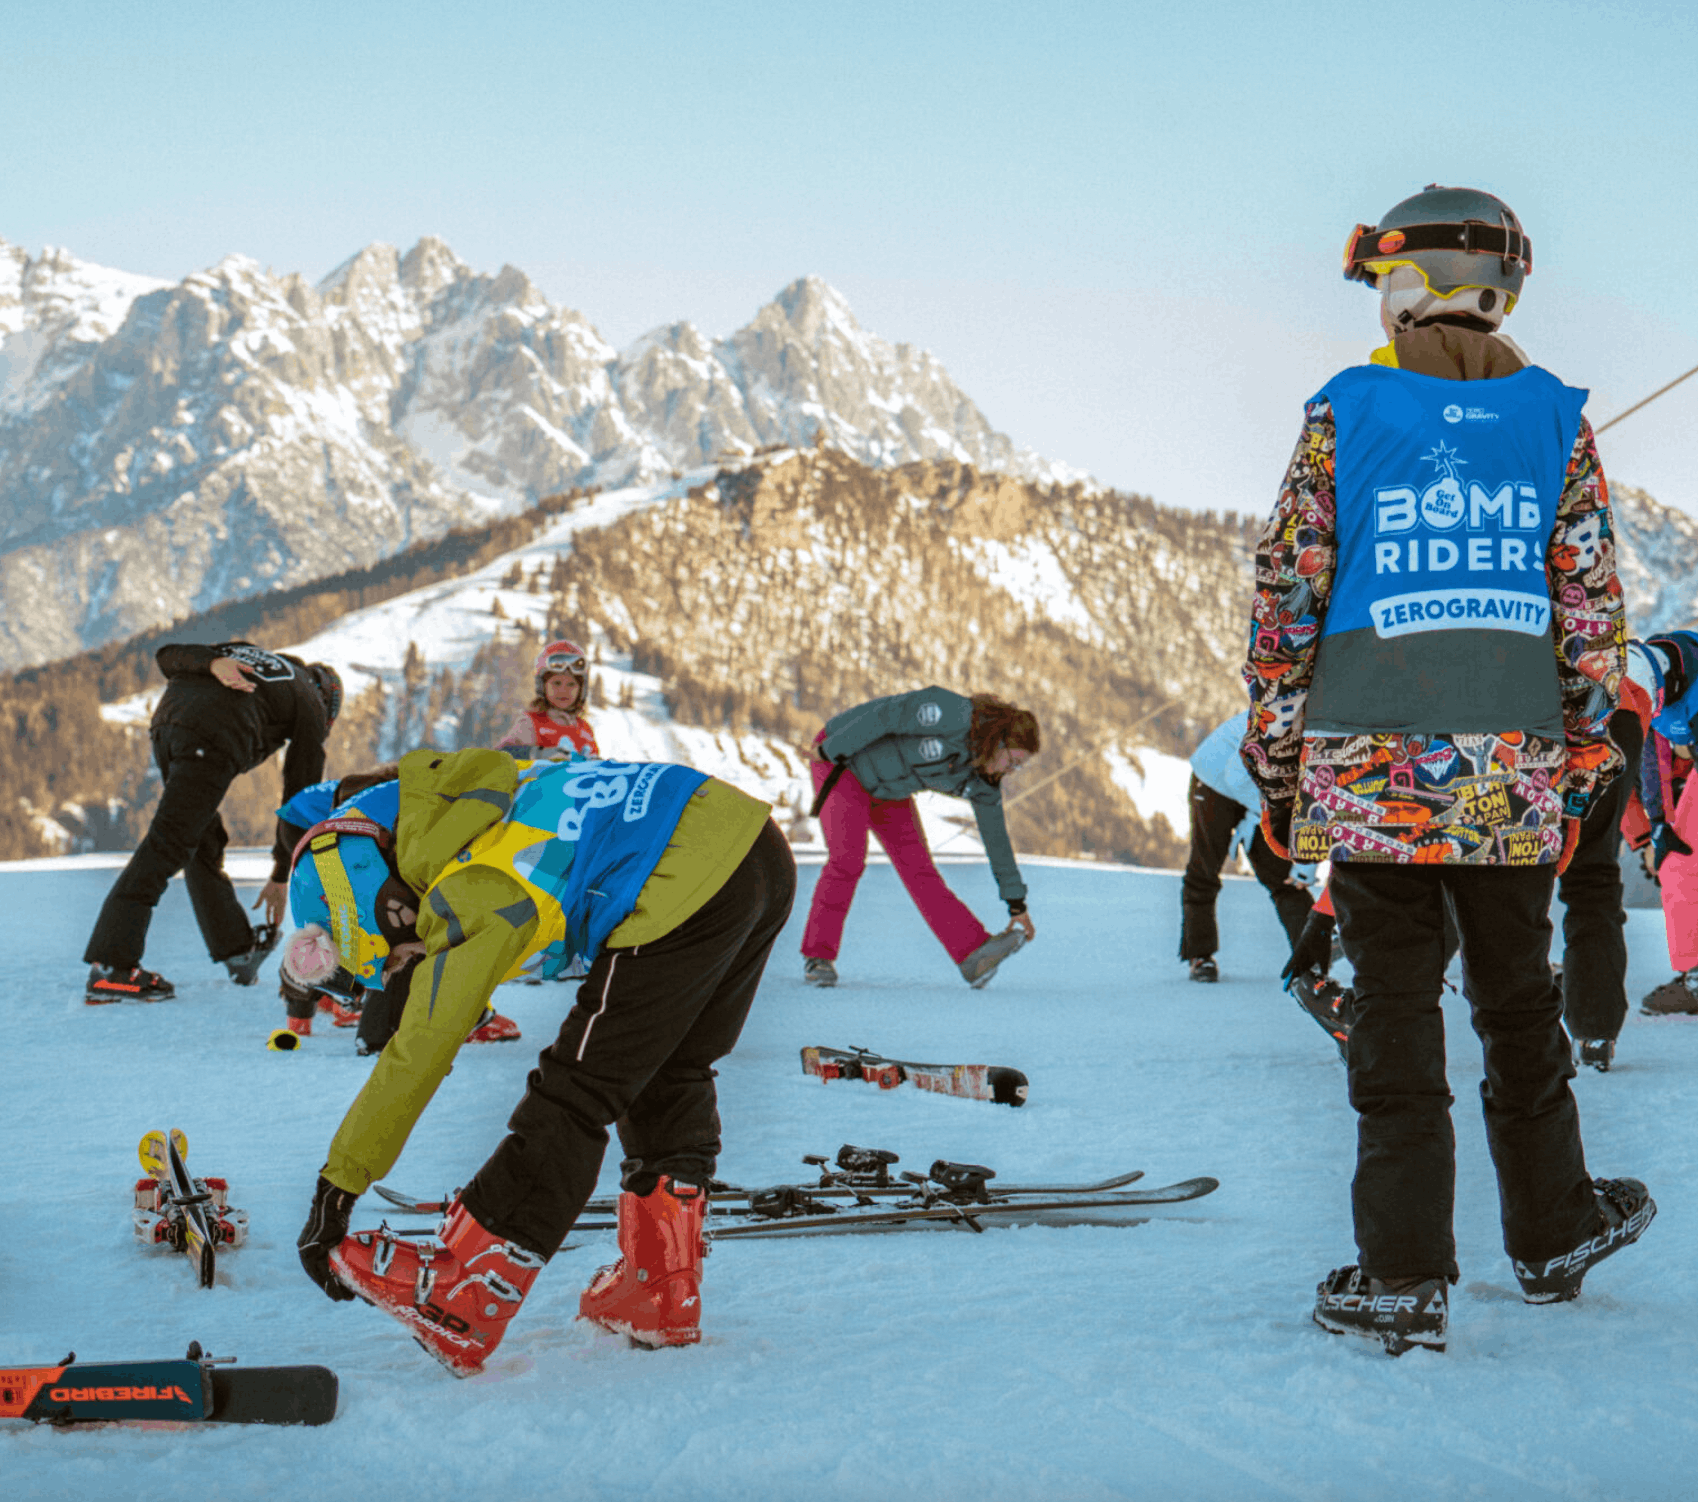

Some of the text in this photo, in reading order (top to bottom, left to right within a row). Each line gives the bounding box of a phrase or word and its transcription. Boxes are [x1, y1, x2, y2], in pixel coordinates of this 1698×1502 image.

[1380, 598, 1546, 629] ZEROGRAVITY
[1476, 806, 1507, 826] APAN
[1319, 1294, 1418, 1313] ISCHER
[50, 1386, 173, 1403] FIREBIRD
